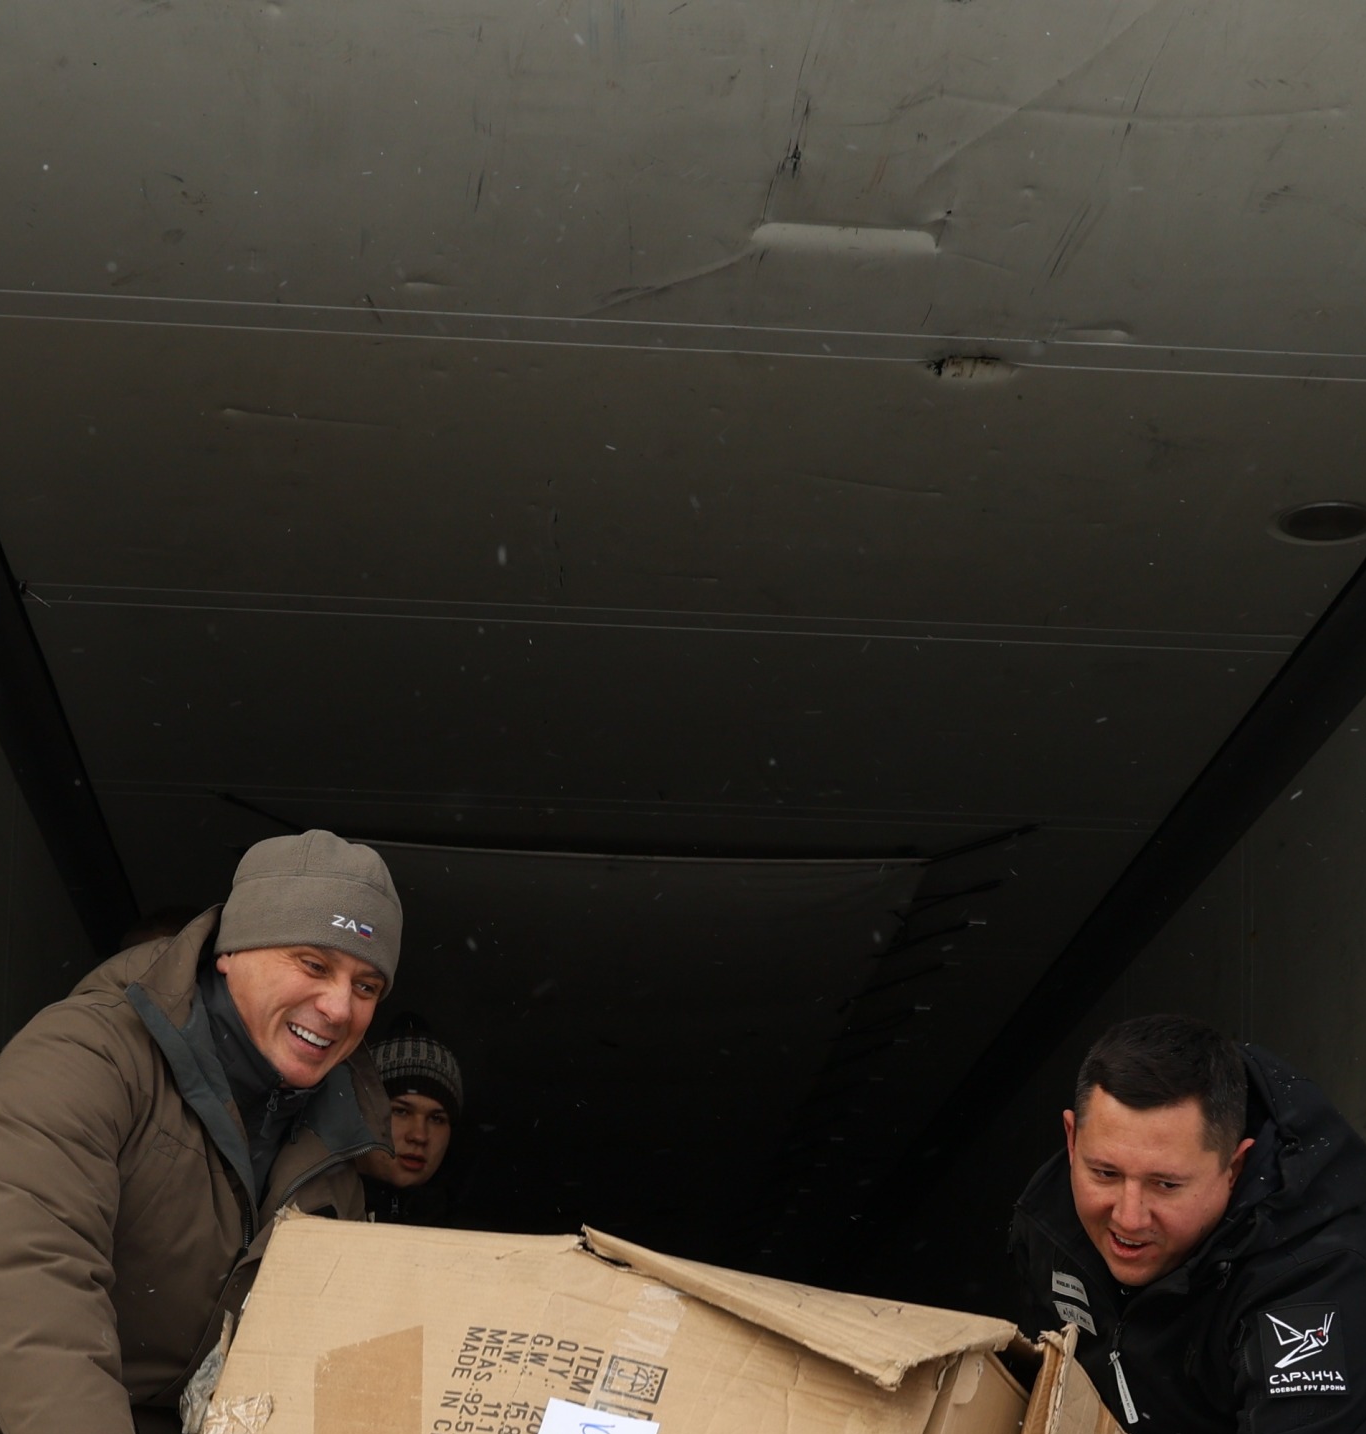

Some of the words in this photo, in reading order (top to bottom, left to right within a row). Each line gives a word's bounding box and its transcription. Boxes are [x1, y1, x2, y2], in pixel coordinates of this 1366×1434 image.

[331, 914, 358, 933] ZA
[451, 1326, 486, 1379] MADE
[569, 1346, 605, 1395] ITEM
[1269, 1370, 1344, 1385] САРАНЧА
[1320, 1384, 1347, 1392] ДРОНЫ
[440, 1390, 463, 1409] IN
[476, 1401, 502, 1434] 11.1
